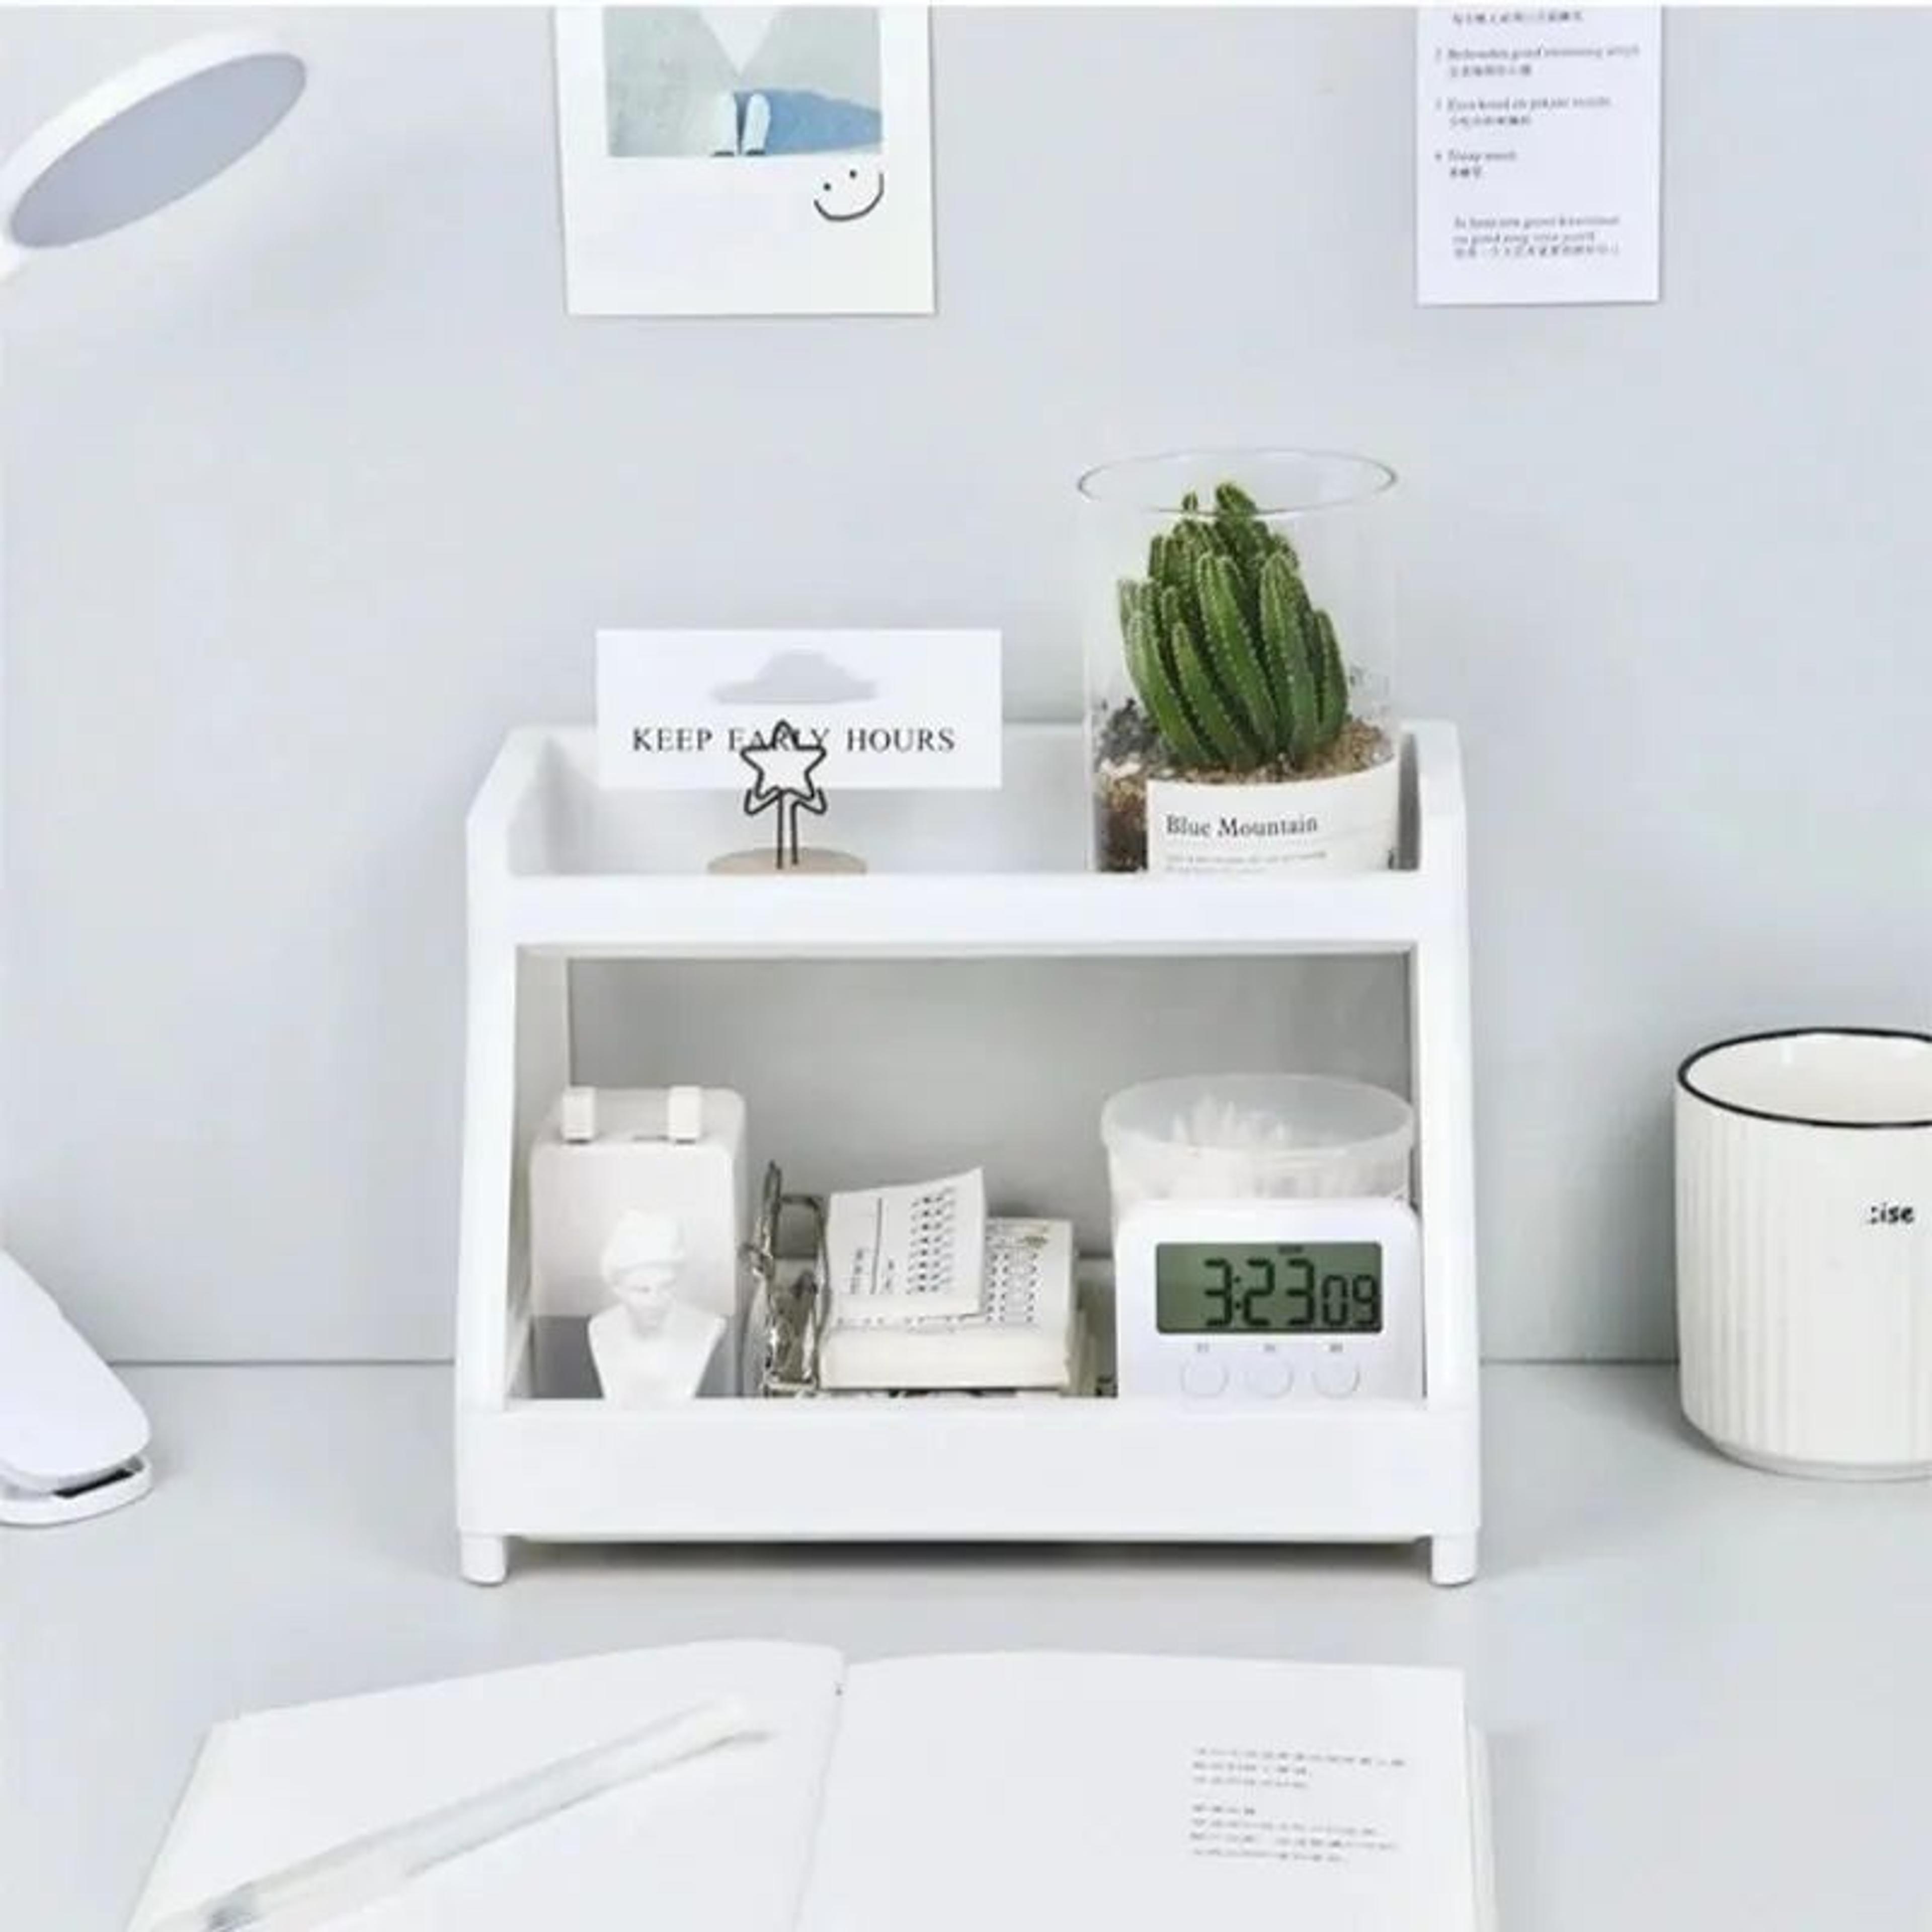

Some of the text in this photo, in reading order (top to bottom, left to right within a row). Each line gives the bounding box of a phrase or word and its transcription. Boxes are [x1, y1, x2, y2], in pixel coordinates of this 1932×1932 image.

[633, 728, 713, 751] KEEP
[847, 727, 954, 753] HOURS
[1166, 814, 1318, 838] Blue Mountain
